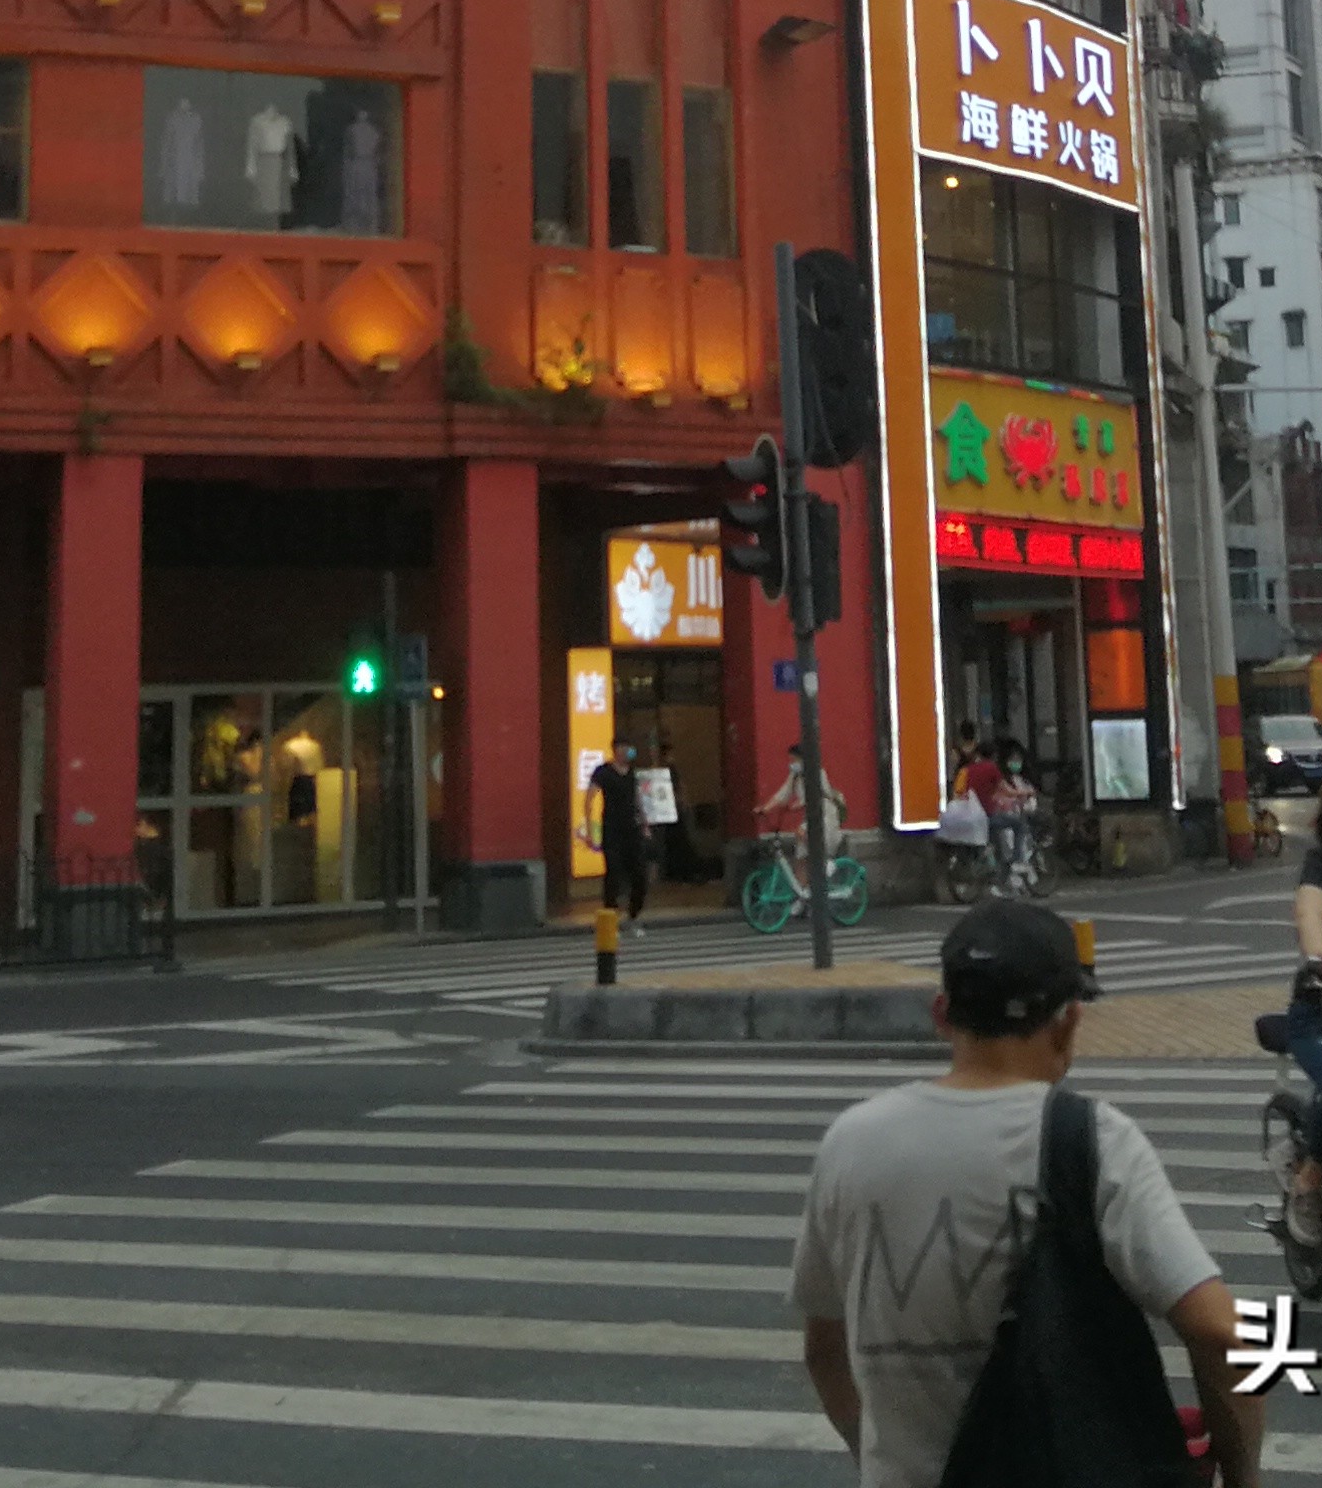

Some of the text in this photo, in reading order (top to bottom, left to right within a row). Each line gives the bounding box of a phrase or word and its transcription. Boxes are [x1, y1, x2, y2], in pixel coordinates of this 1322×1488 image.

[959, 90, 1120, 185] 海鲜火锅
[938, 399, 991, 486] 食
